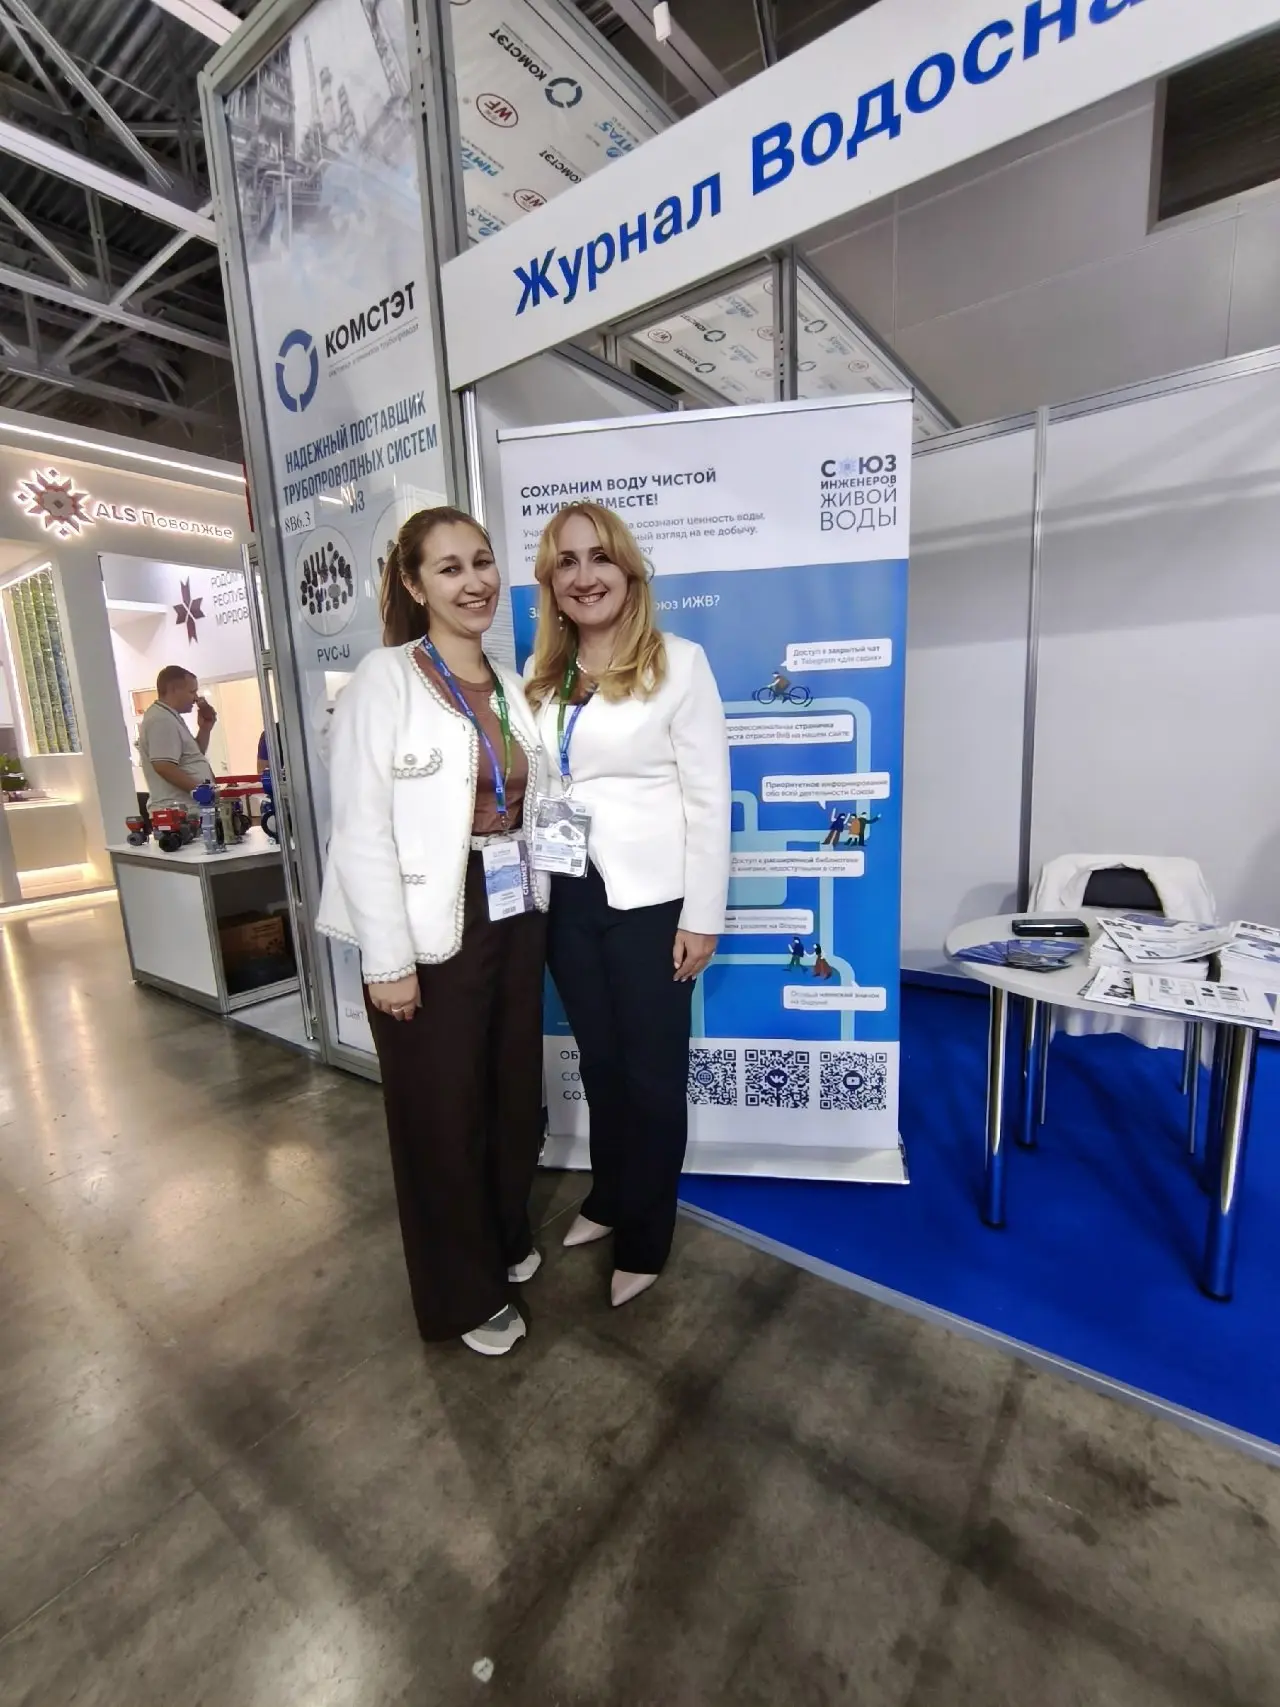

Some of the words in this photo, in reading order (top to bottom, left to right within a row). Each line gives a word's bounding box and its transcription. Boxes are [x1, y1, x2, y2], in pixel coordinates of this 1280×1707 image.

[489, 28, 547, 81] КОМСТЭТ
[484, 100, 513, 121] WF
[513, 173, 721, 315] Журнал
[325, 281, 415, 358] КОМСТЭТ
[285, 423, 348, 473] НАДЕЖНЫЙ
[350, 390, 427, 445] ПОСТАВЩИК
[283, 447, 385, 506] ТРУБОПРОВОДНЫХ
[387, 424, 438, 465] СИСТЕМ
[520, 479, 602, 498] СОХРАНИМ
[607, 475, 648, 491] ВОДУ
[651, 467, 717, 486] ЧИСТОЙ
[820, 475, 897, 490] ИНЖЕНЕРОВ
[522, 504, 532, 517] И
[596, 493, 658, 510] ВМЕСТЕ!
[820, 485, 897, 508] ЖИВОЙ
[96, 502, 137, 523] ALS
[141, 510, 233, 539] Поволжье
[636, 518, 685, 529] осознают
[687, 514, 734, 526] ценность
[820, 506, 897, 532] ВОДЫ
[655, 529, 688, 541] взгляд
[689, 529, 701, 538] на
[682, 594, 720, 608] ИЖВ?
[215, 606, 249, 626] МОРДОВ
[317, 643, 350, 663] PVC-U
